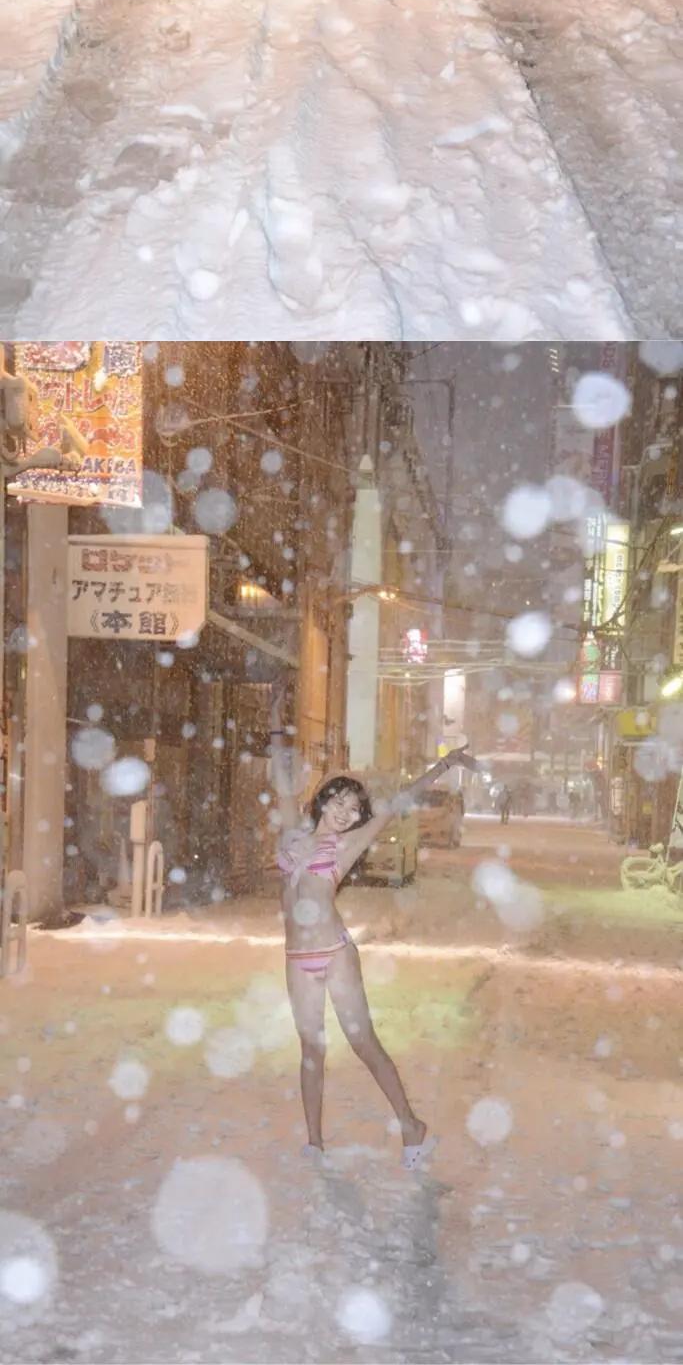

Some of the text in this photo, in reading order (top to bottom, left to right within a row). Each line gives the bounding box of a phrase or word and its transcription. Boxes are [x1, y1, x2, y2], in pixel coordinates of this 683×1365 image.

[80, 455, 137, 474] AKIBA
[81, 548, 189, 574] ロケット
